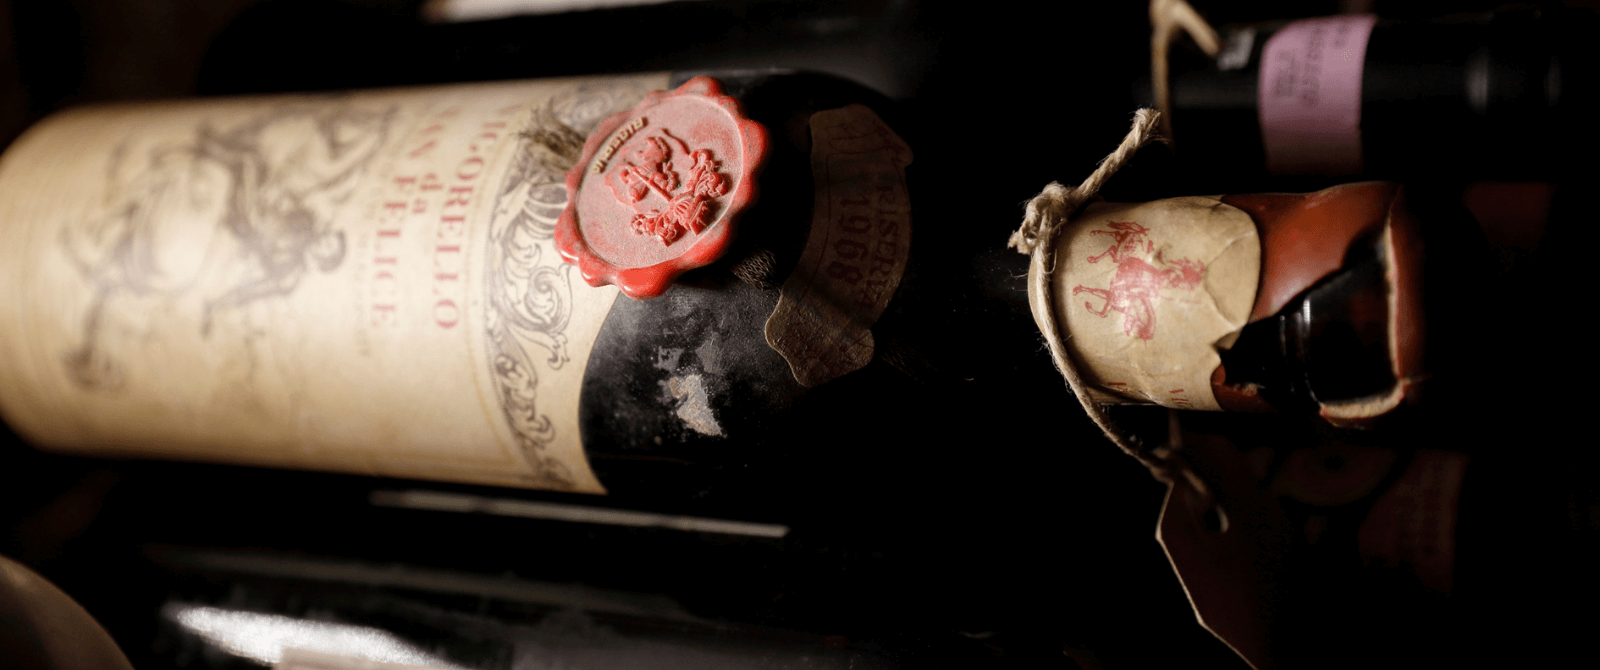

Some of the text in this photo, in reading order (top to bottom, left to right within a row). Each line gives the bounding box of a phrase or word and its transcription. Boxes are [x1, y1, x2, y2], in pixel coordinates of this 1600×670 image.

[413, 172, 444, 214] da
[825, 195, 872, 286] 1968
[371, 176, 418, 327] FELICE
[853, 185, 900, 310] RISERVA
